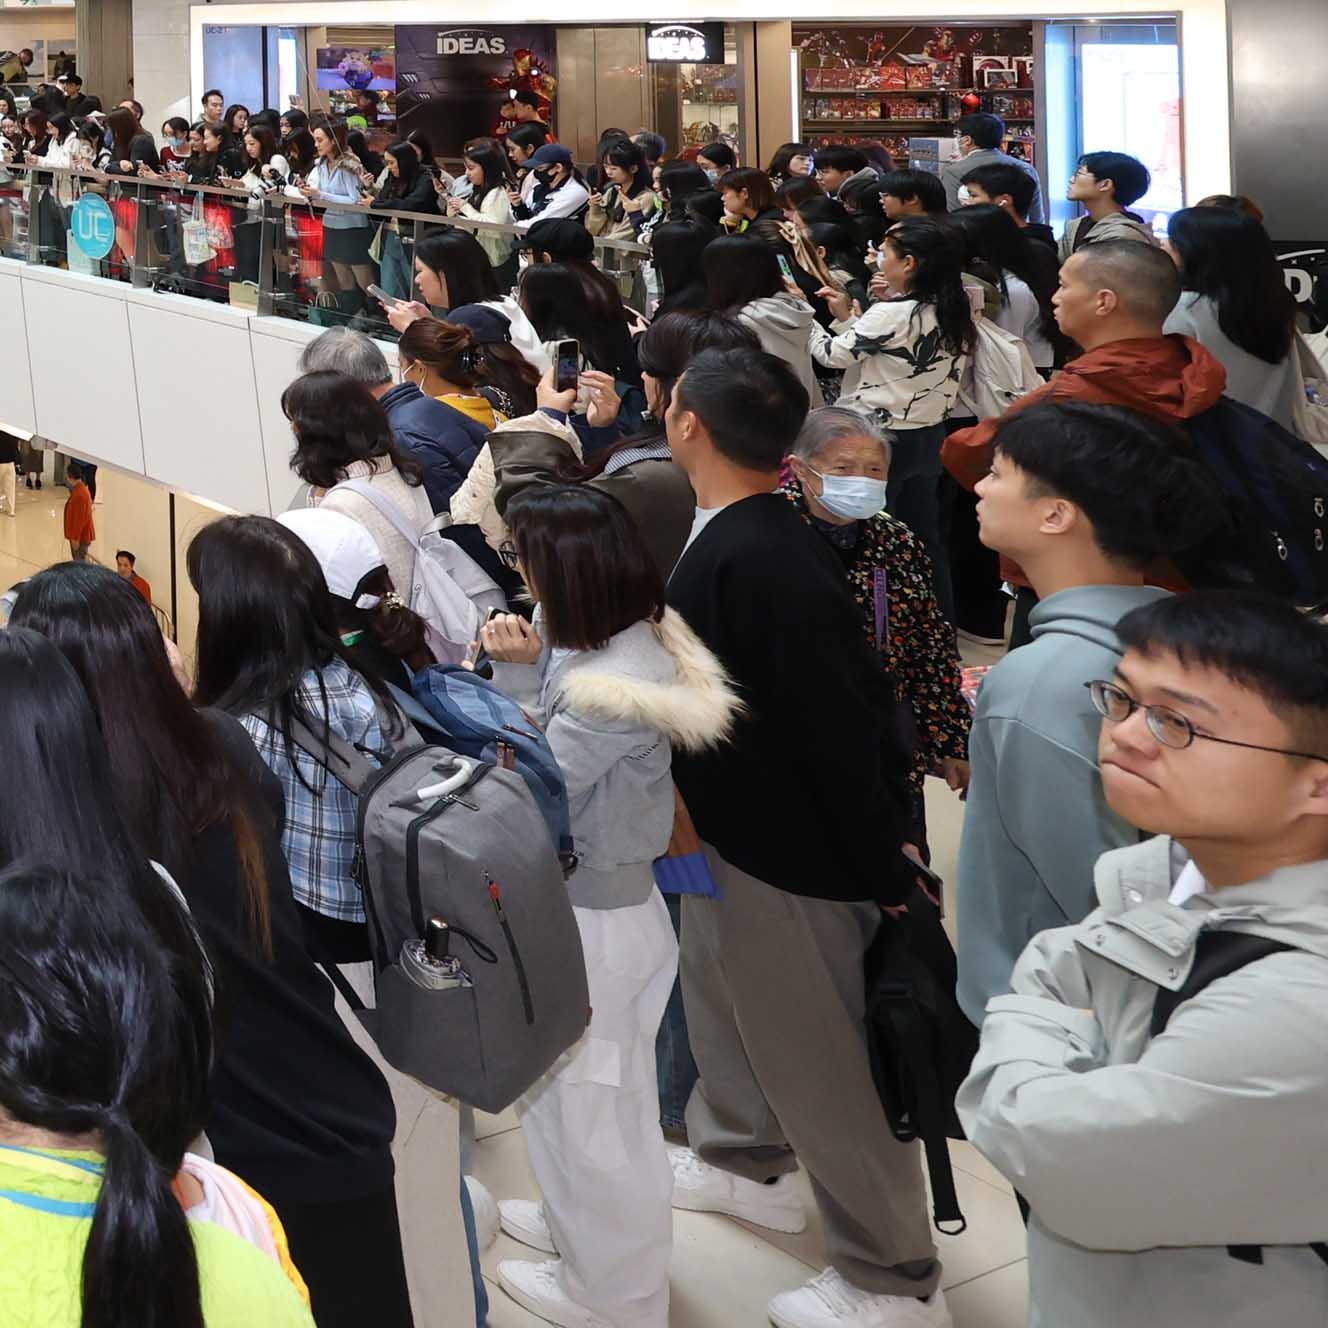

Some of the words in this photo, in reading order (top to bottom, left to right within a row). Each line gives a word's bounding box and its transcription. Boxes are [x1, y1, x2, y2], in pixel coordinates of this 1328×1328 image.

[437, 37, 505, 55] IDEAS
[648, 37, 706, 59] IDEAS
[78, 208, 111, 243] UC
